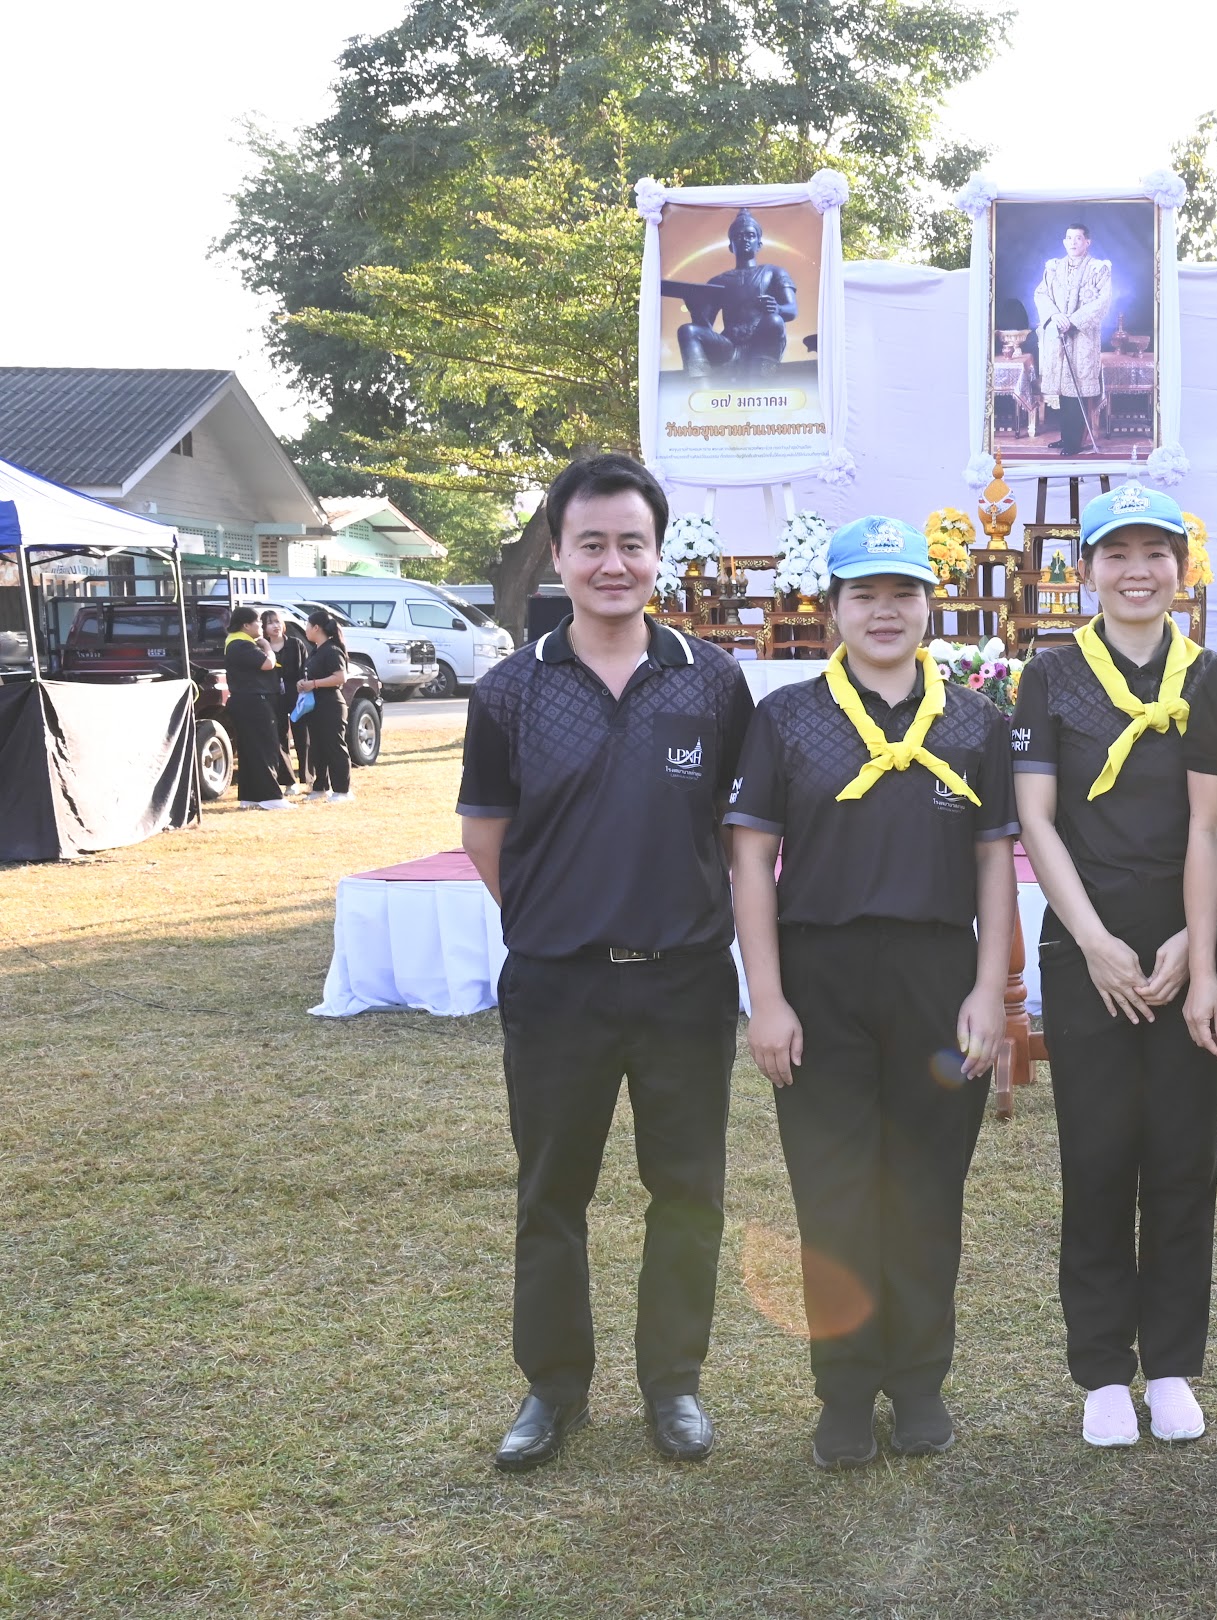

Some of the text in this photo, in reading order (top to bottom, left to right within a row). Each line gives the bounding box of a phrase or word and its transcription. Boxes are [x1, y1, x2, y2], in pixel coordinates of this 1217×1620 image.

[711, 394, 787, 408] ๑๗ มกราคม
